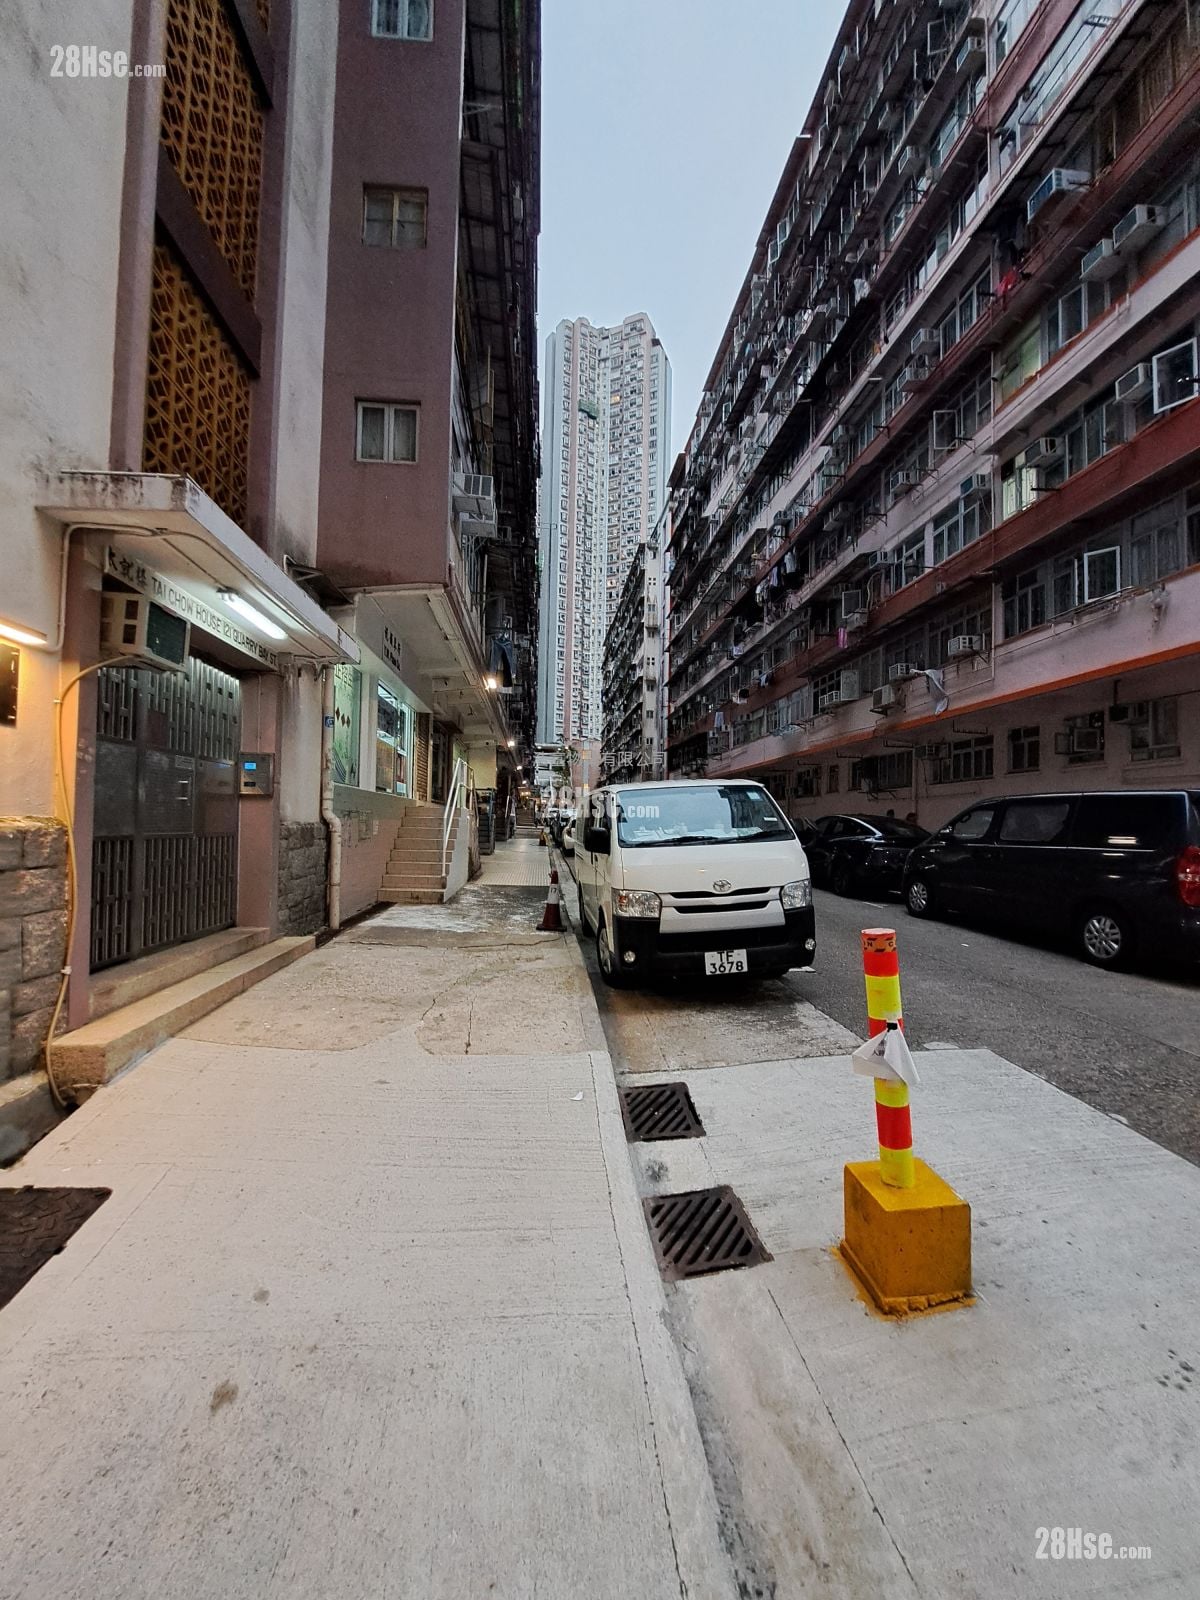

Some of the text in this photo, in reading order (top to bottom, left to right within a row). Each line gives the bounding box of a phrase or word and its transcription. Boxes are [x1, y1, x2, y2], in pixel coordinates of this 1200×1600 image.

[151, 576, 166, 599] TAI
[168, 588, 193, 615] CHOW
[196, 603, 222, 633] HOUSE
[223, 621, 232, 638] 121
[232, 628, 258, 654] QUARRY
[258, 643, 269, 659] BAY
[716, 950, 734, 962] TF
[709, 960, 744, 973] 3678
